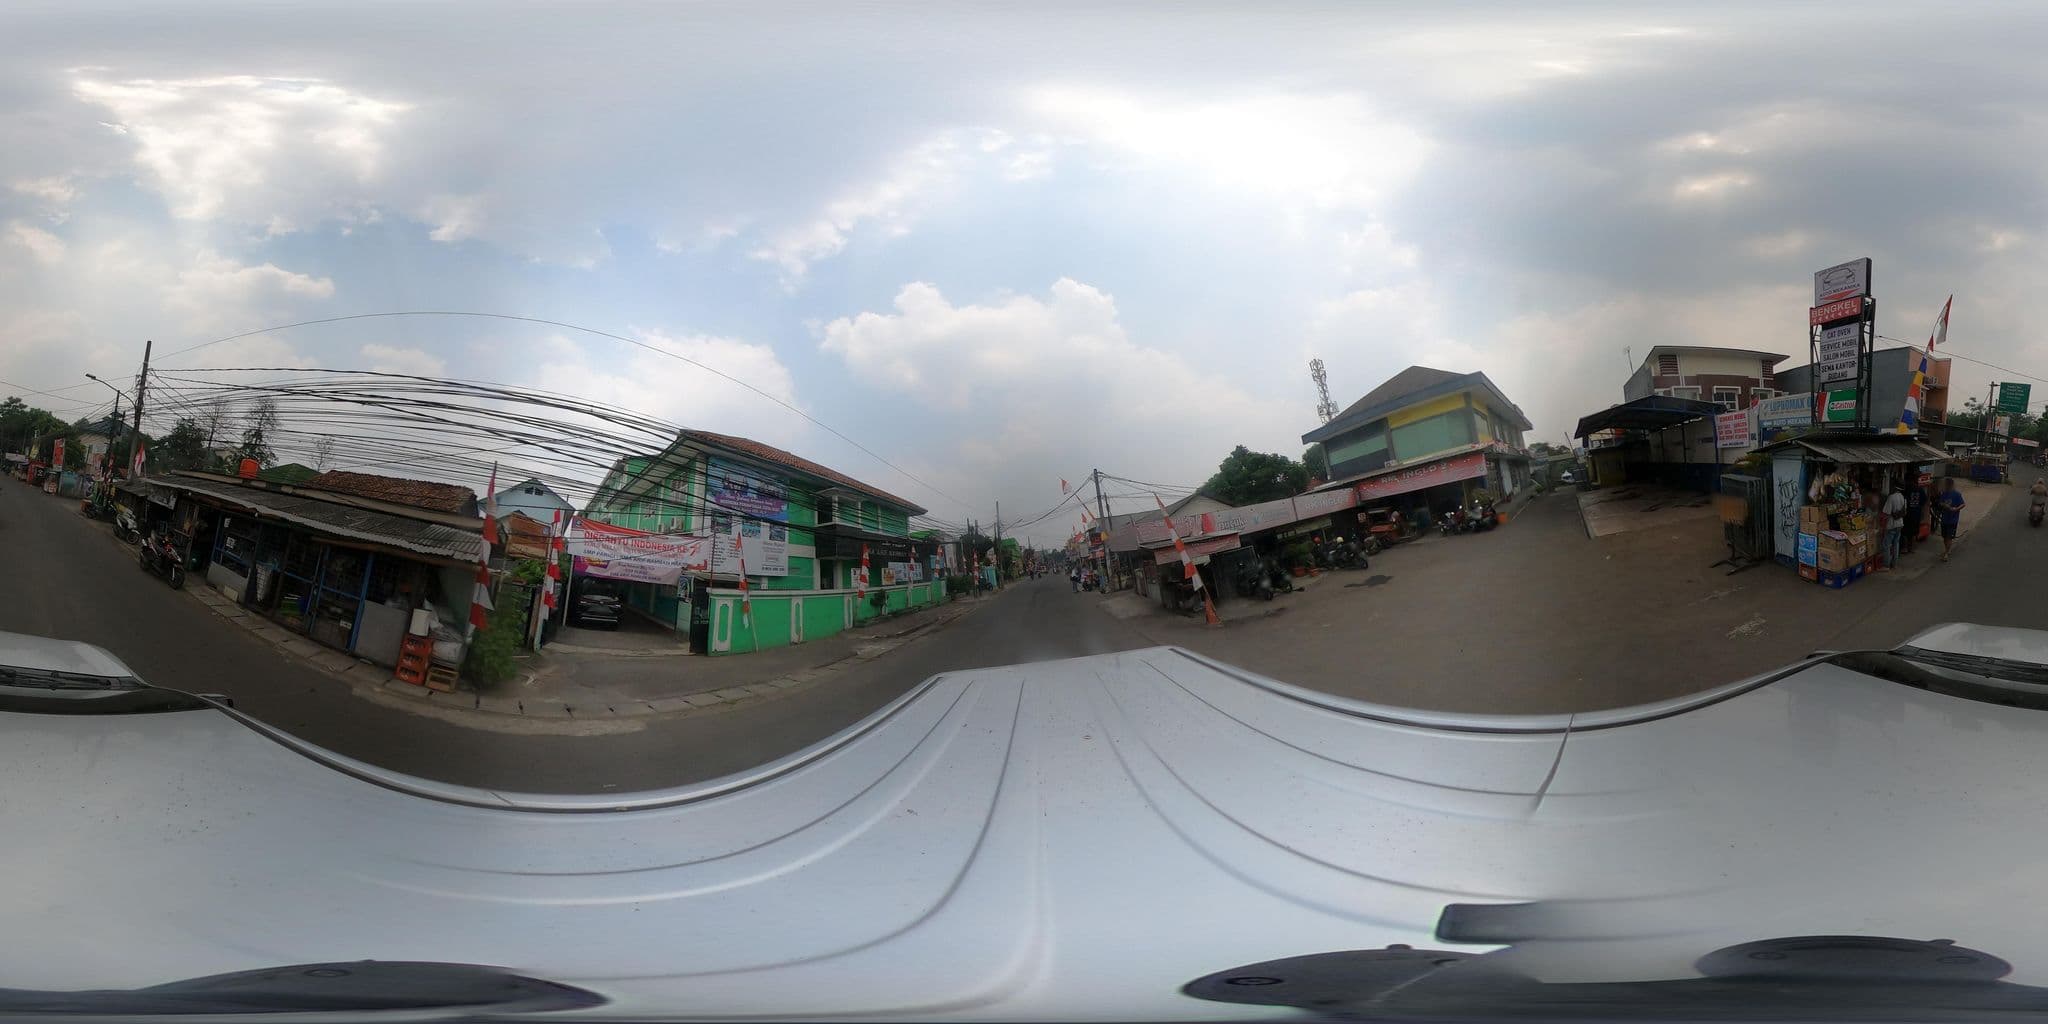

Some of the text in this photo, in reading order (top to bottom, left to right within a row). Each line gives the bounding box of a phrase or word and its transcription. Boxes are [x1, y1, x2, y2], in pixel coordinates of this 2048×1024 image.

[1811, 300, 1857, 317] BENGKEL
[1821, 338, 1857, 350] SERVICE MOBIL
[1823, 349, 1855, 361] SALON MOBIL
[1832, 400, 1856, 409] Castrol
[631, 539, 677, 552] INDONESIA
